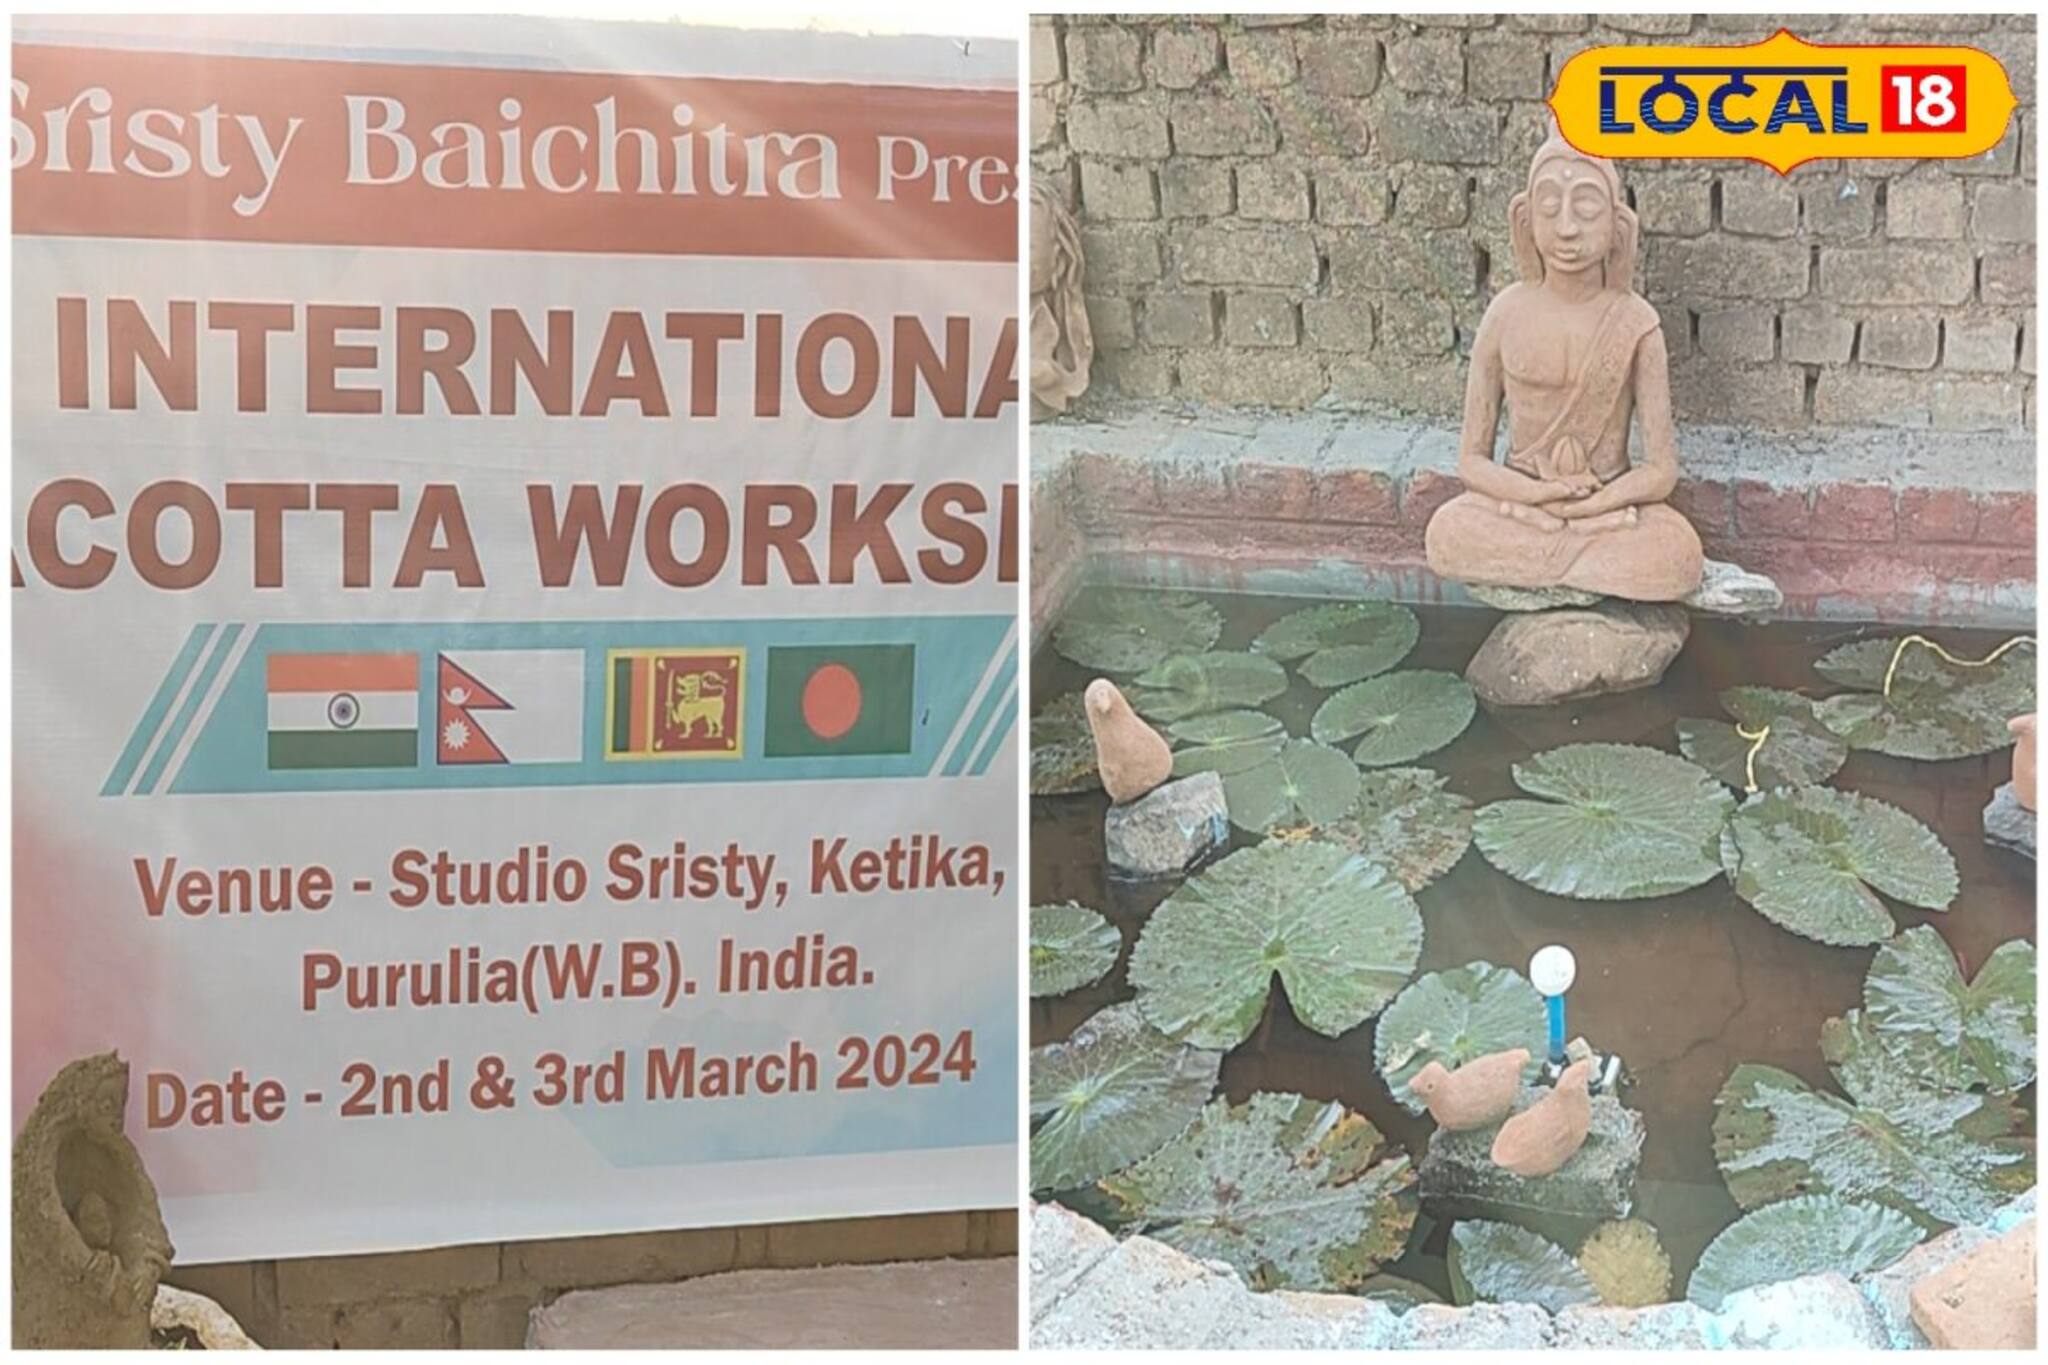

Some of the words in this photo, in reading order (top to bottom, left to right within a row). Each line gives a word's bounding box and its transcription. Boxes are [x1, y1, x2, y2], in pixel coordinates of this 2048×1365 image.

[344, 95, 842, 199] Baichitra
[877, 136, 1019, 204] Pre
[11, 479, 485, 589] COTTA
[526, 482, 1018, 588] WORKS
[134, 857, 333, 917] Venue
[389, 845, 588, 908] Studio
[605, 841, 788, 910] Sristy,
[810, 834, 1005, 896] Ketika,
[303, 940, 696, 1014] Purulia(W.B).
[718, 934, 874, 993] India.
[146, 1070, 286, 1129] Date
[340, 1059, 449, 1117] 2nd
[470, 1056, 515, 1109] &
[533, 1051, 625, 1106] 3rd
[646, 1041, 818, 1101] March
[836, 1030, 976, 1090] 2024
